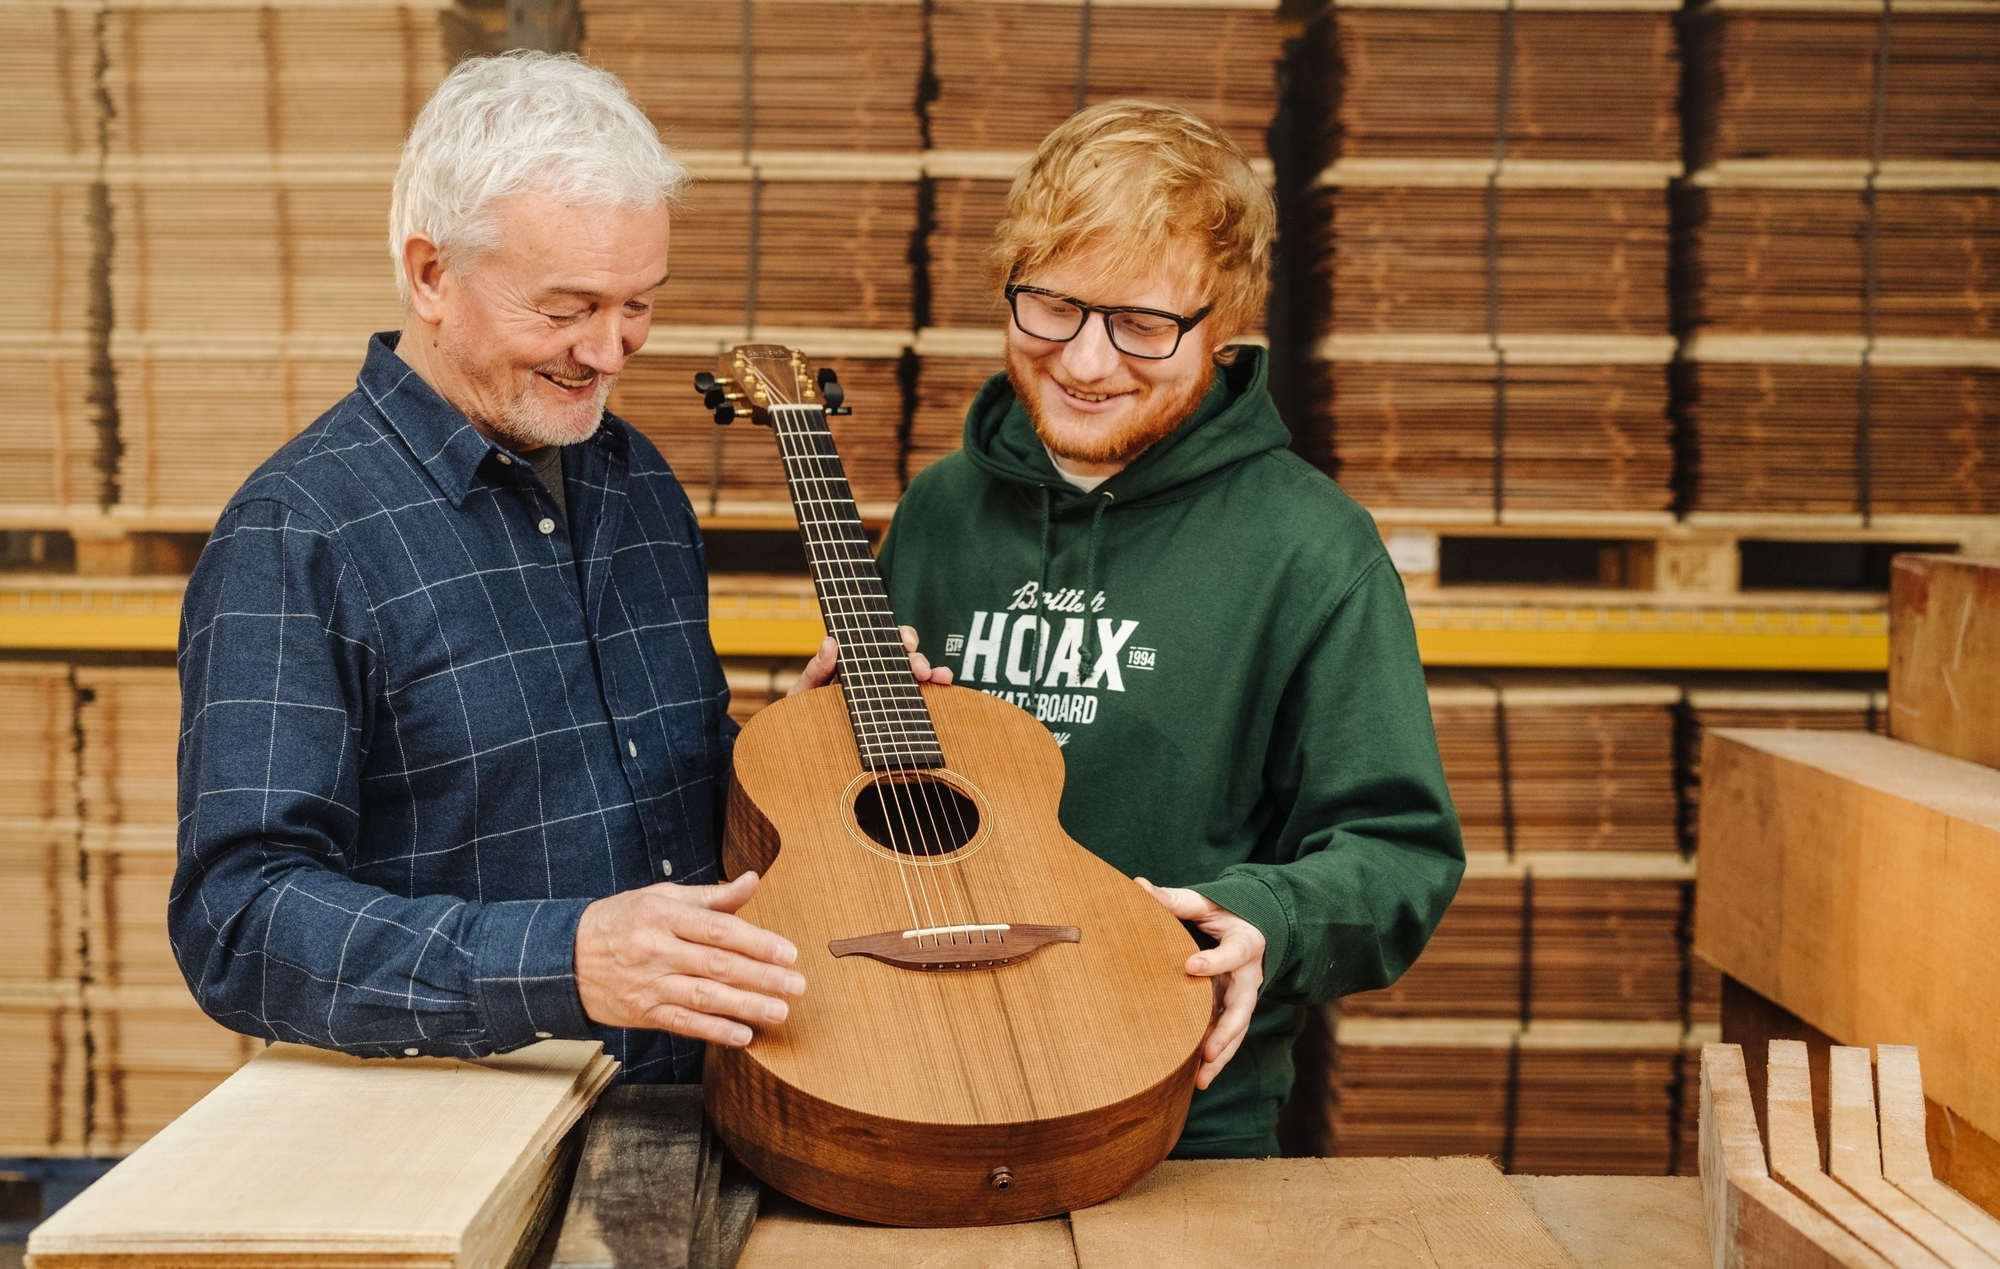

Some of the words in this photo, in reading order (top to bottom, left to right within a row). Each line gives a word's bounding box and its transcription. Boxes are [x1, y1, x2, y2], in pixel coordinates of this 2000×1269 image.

[959, 610, 1140, 692] HOAX
[1128, 649, 1156, 667] 1994
[981, 689, 1098, 724] TBOARD
